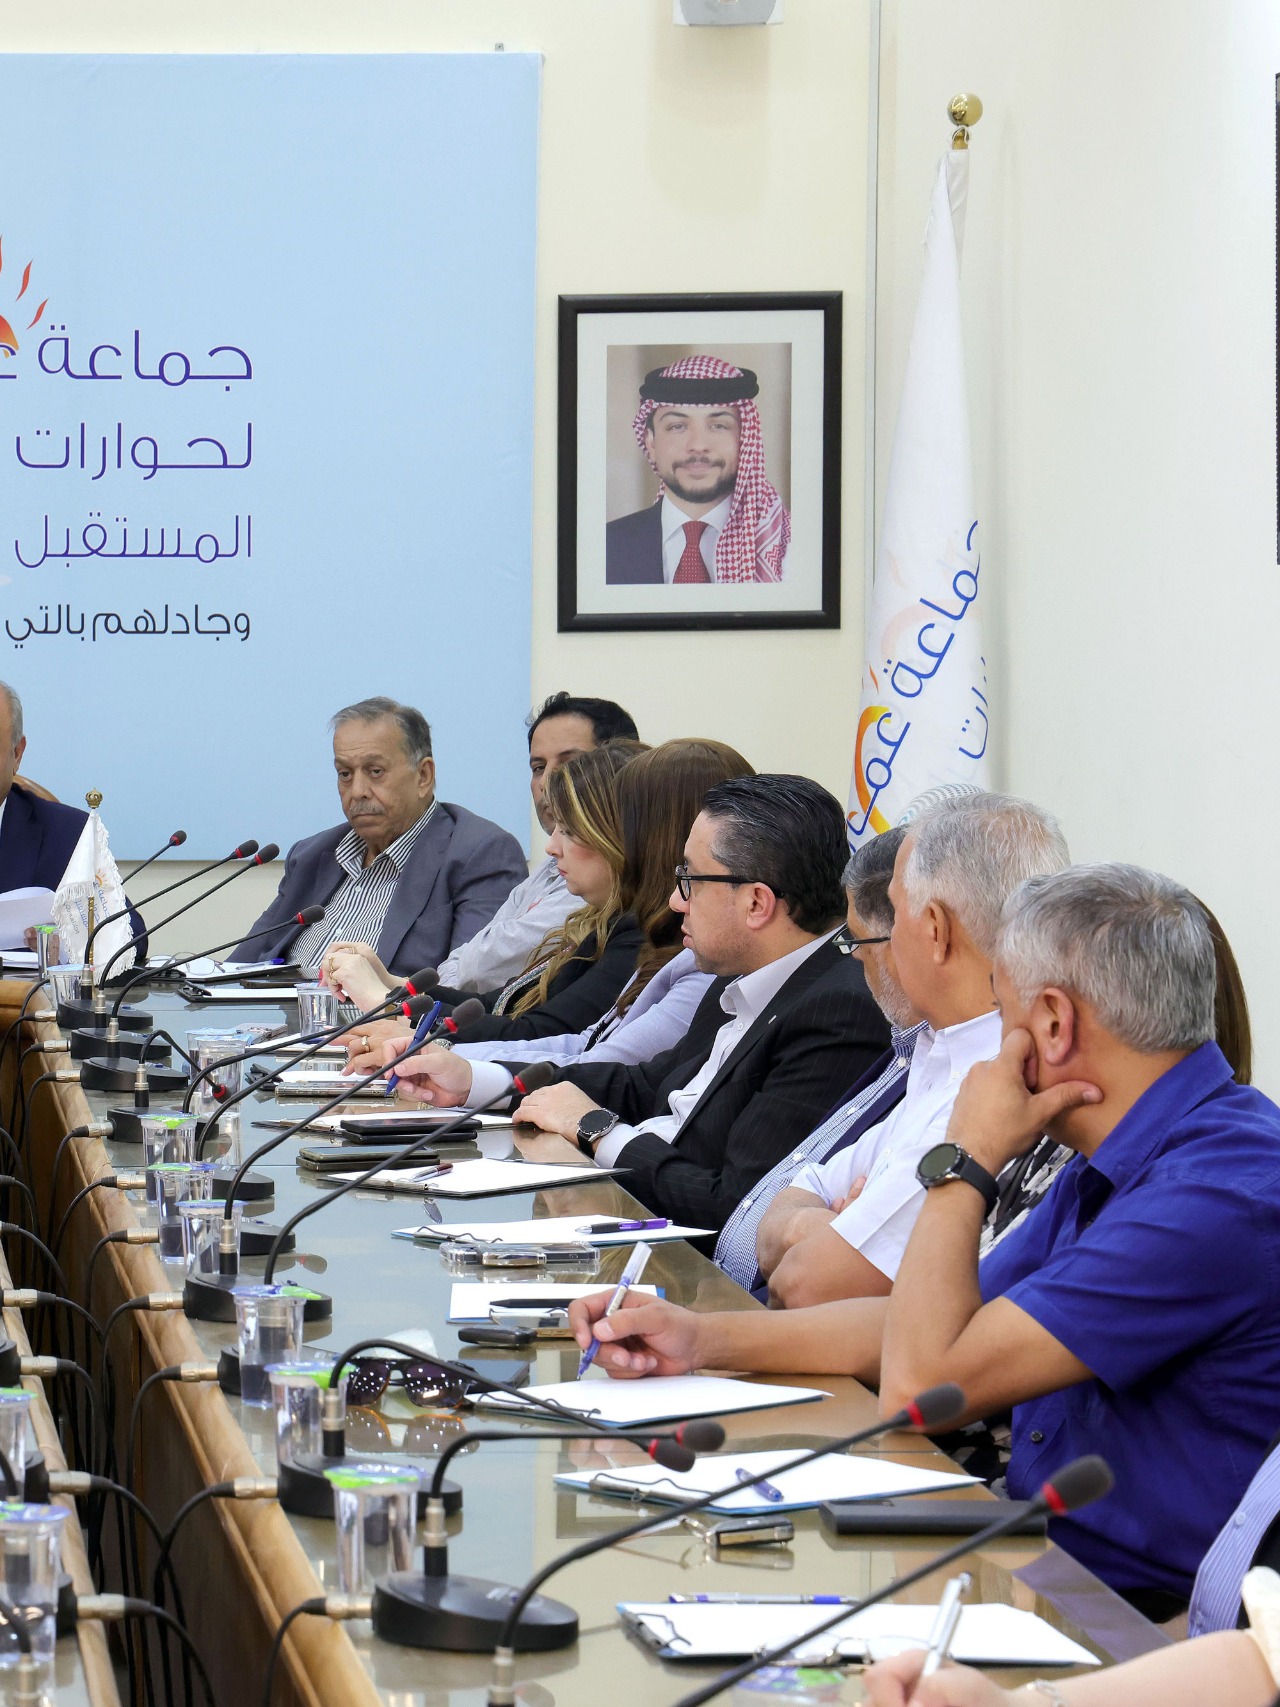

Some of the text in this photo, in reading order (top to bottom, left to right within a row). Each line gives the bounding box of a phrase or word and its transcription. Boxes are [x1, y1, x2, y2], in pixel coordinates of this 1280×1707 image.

[37, 324, 253, 392] جماعة
[15, 421, 253, 481] لحوارات
[14, 511, 252, 569] المستقبل
[5, 604, 86, 649] بالتي
[92, 604, 251, 642] وجادلهم
[846, 711, 912, 853] عما
